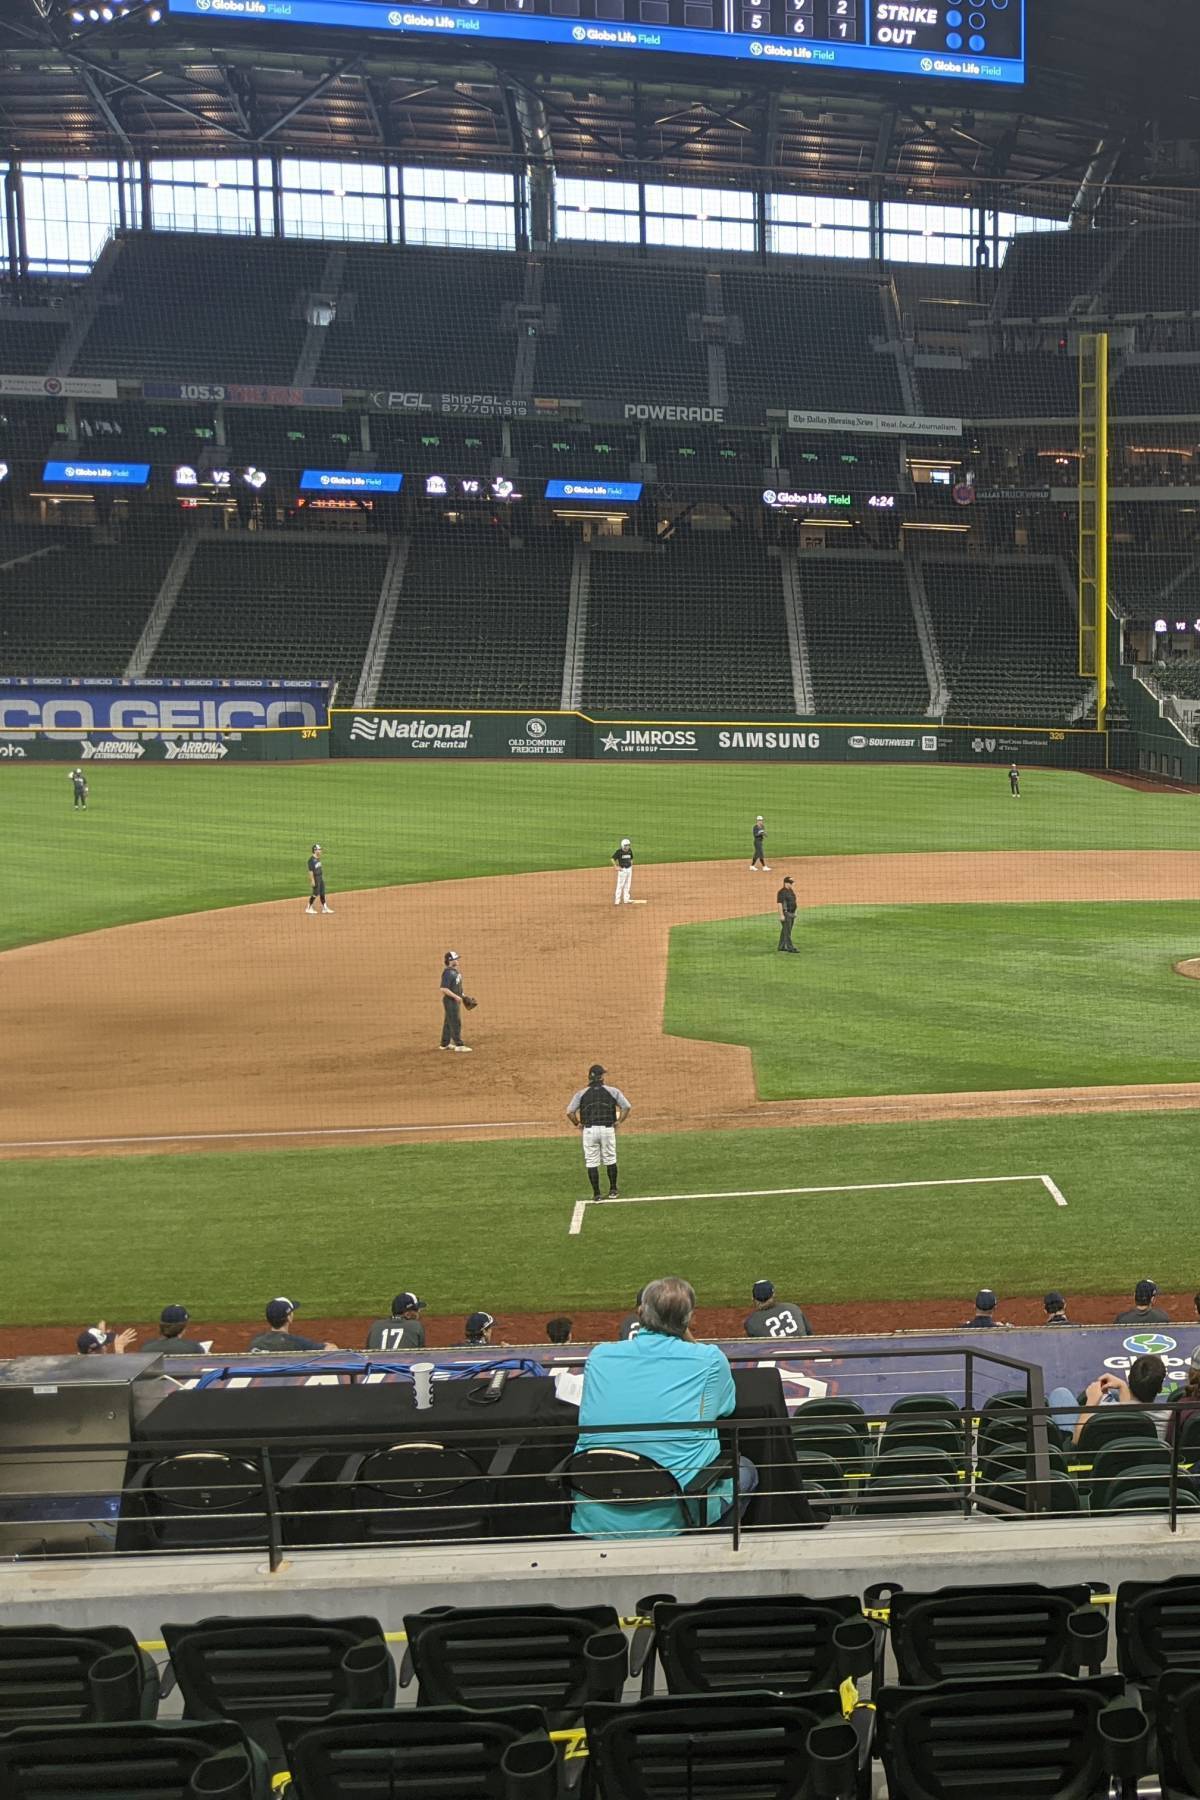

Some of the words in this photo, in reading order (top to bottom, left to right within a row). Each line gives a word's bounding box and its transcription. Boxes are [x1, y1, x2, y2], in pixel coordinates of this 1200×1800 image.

[212, 0, 245, 11] Globe
[245, 1, 266, 13] Life
[267, 4, 291, 14] Field
[837, 1, 847, 14] 2
[877, 4, 937, 24] STRIKE
[403, 13, 434, 26] Globe
[435, 16, 455, 28] Life
[456, 19, 480, 30] Field
[751, 14, 762, 28] 5
[794, 19, 804, 33] 6
[839, 23, 847, 37] 1
[587, 29, 616, 41] Globe
[618, 32, 636, 43] Life
[638, 34, 661, 45] Field
[878, 28, 916, 44] OUT
[763, 45, 793, 57] Globe
[794, 47, 812, 59] Life
[813, 50, 834, 61] Field
[933, 60, 961, 72] Globe
[962, 63, 980, 74] Life
[981, 65, 1002, 76] Field
[180, 385, 224, 400] 105.3
[388, 393, 432, 408] PGL
[441, 394, 527, 407] ShipPGL.com
[624, 404, 724, 422] POWERADE
[806, 416, 827, 424] Dallas
[827, 416, 856, 426] Morning
[856, 418, 874, 426] News
[75, 468, 97, 477] Globe
[98, 468, 112, 477] Life
[330, 476, 351, 485] Globe
[352, 477, 365, 485] Life
[777, 492, 807, 503] Globe
[808, 493, 827, 504] Life
[828, 494, 851, 505] Field
[868, 496, 894, 507] 4:24
[110, 700, 317, 741] GEICO
[302, 730, 317, 739] 374
[379, 719, 471, 739] National
[1049, 732, 1065, 740] 326
[97, 742, 136, 753] ARROW
[180, 742, 218, 753] ARROW
[411, 740, 430, 748] Car
[433, 740, 468, 749] Rental
[718, 732, 820, 749] SAMSUNG
[869, 738, 915, 747] SOUTHWEST
[546, 746, 564, 754] LINE
[765, 1310, 798, 1337] 23
[381, 1328, 404, 1350] 17
[1103, 1354, 1192, 1369] Glb
